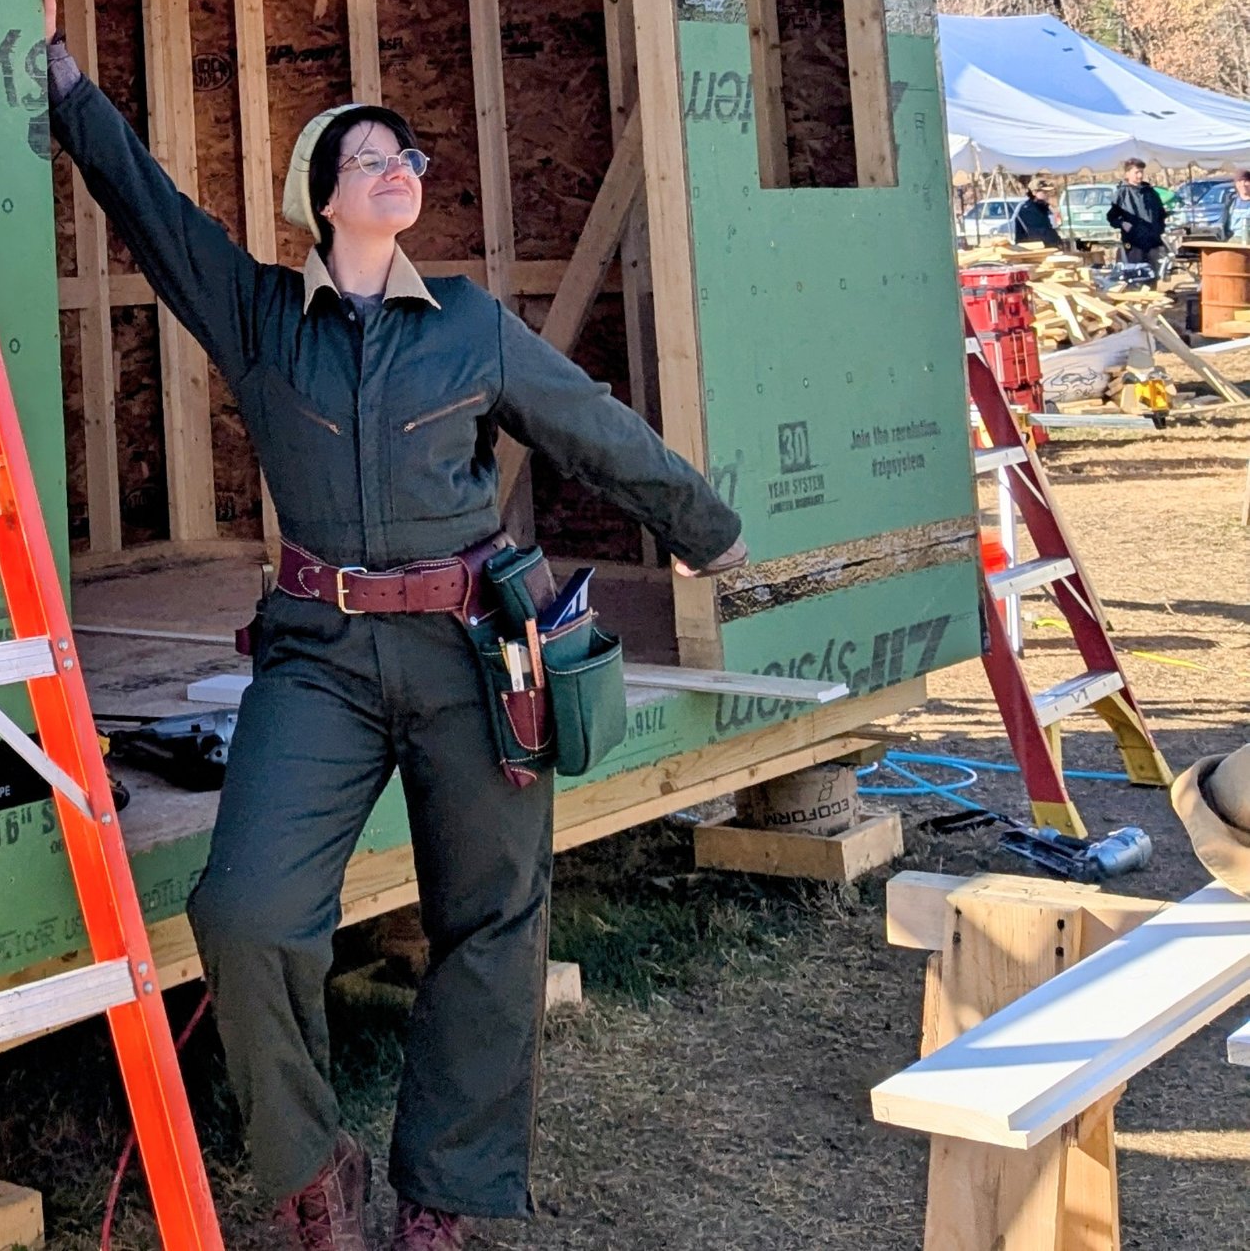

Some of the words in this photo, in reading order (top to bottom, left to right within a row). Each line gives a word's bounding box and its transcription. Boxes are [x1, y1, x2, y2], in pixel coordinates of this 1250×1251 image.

[779, 423, 808, 469] 30
[768, 481, 790, 499] YEAR
[792, 474, 825, 495] SYSTEM
[763, 798, 850, 827] ECOFORM
